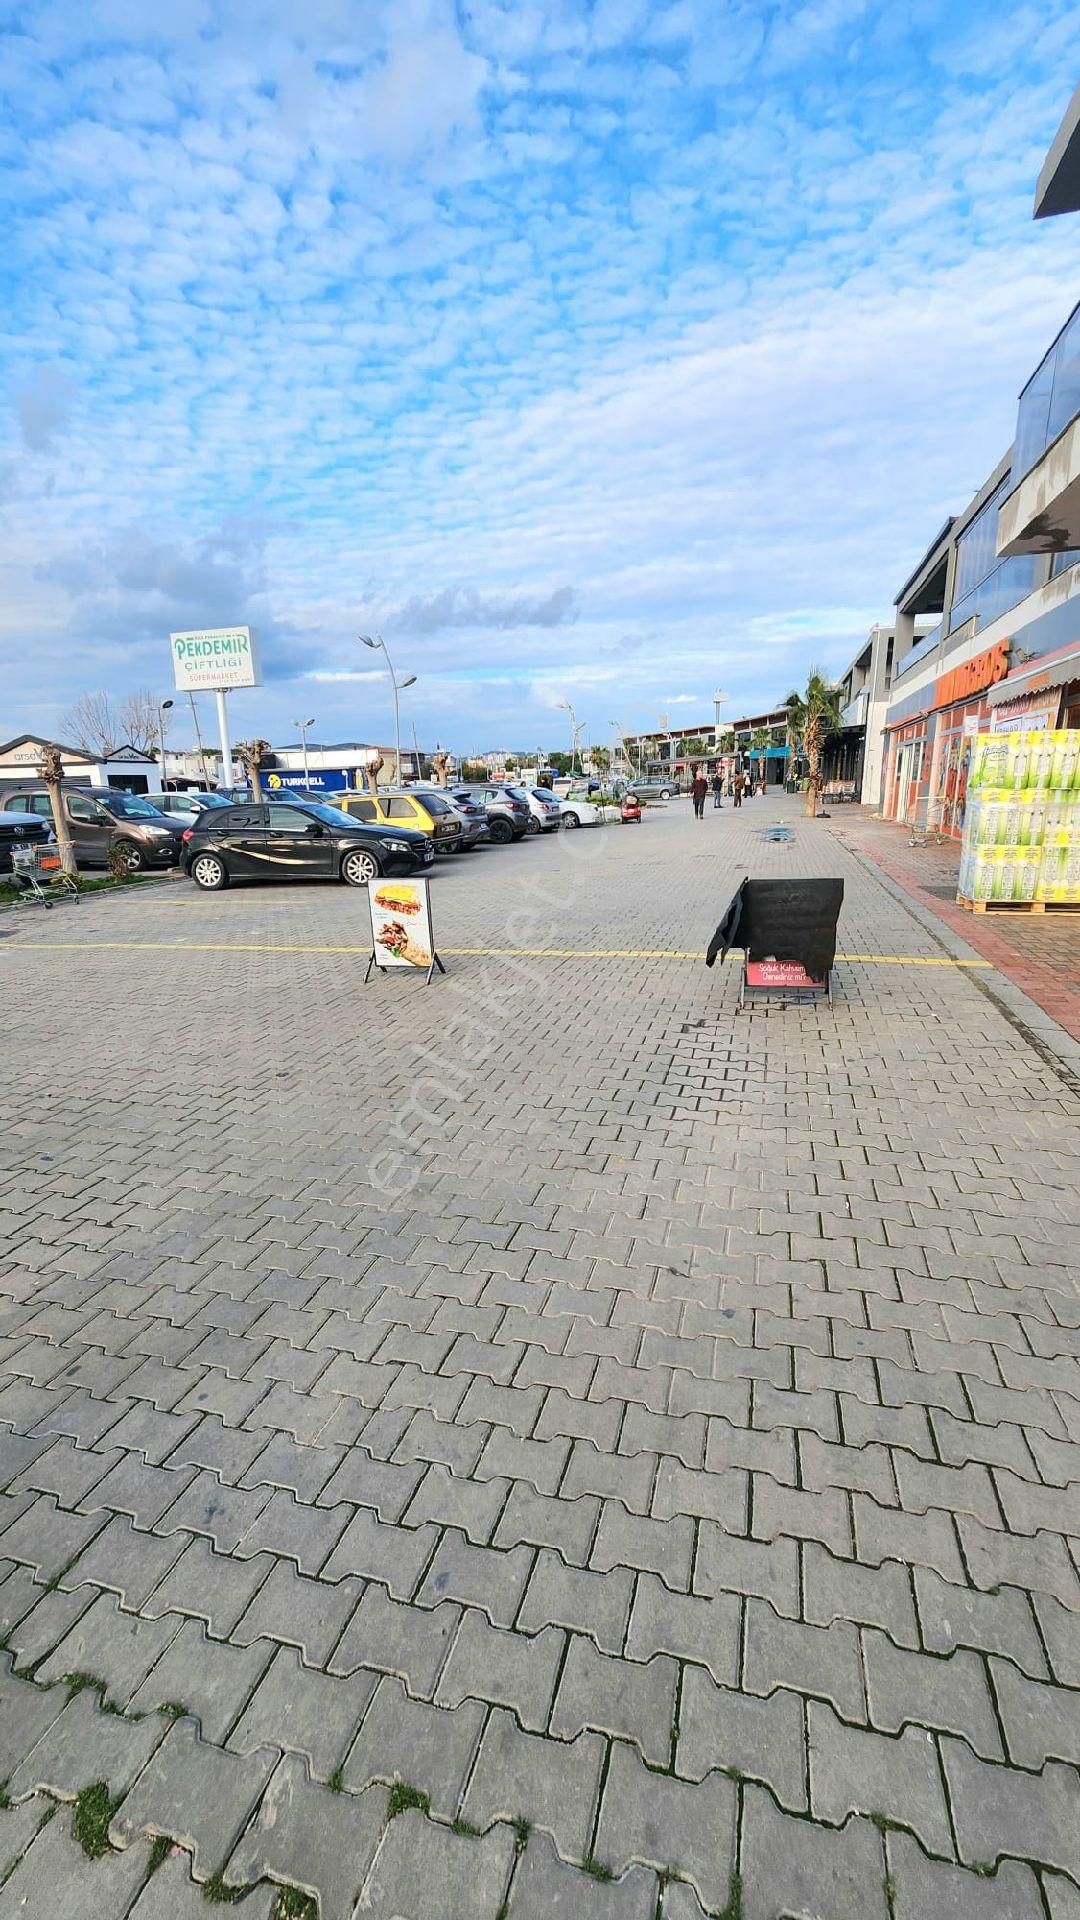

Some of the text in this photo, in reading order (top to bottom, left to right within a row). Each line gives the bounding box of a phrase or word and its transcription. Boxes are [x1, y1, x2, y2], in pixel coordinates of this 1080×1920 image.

[175, 634, 249, 660] PEKDEMİR
[184, 657, 242, 672] ÇİFTLİĞİ
[14, 748, 43, 761] arsaV
[281, 777, 325, 786] TURKCELL
[780, 964, 805, 972] Kahvem
